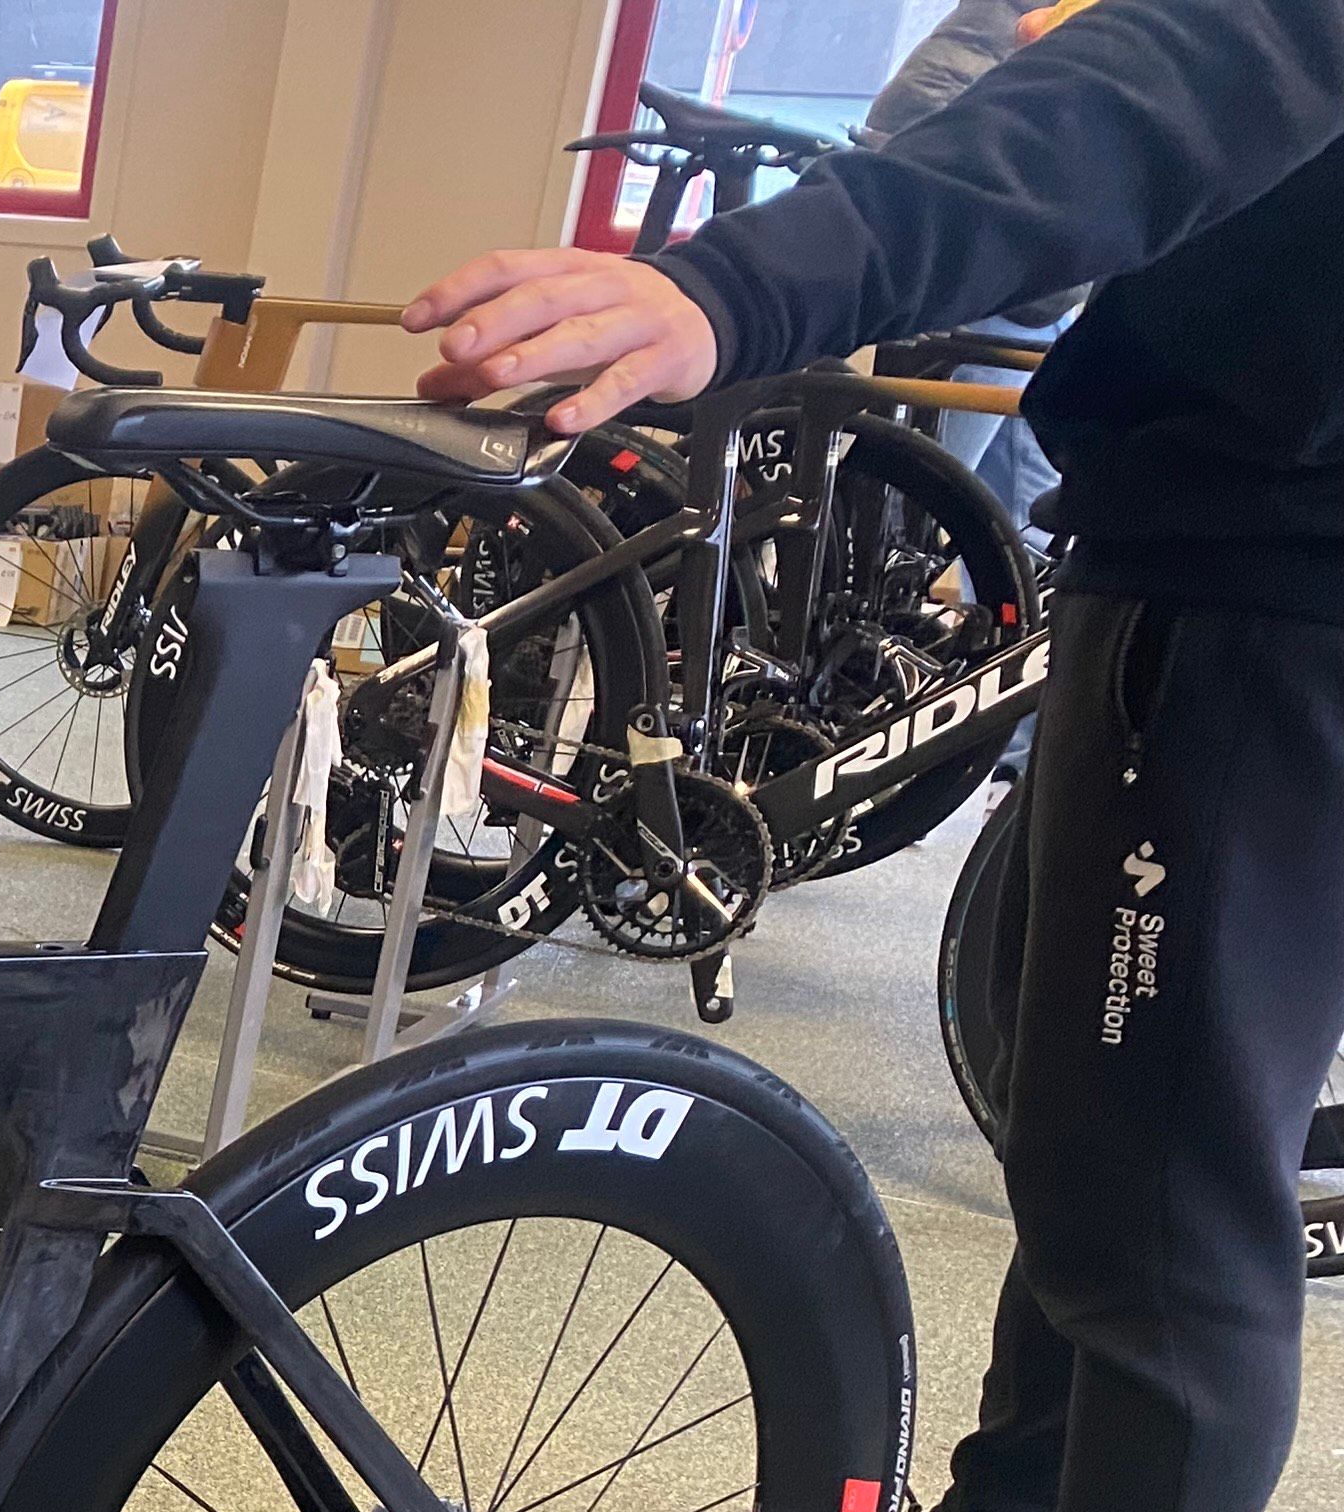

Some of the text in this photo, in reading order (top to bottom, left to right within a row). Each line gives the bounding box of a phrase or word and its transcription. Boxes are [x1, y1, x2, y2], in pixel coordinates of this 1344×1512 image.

[100, 541, 137, 636] RIDLEY
[150, 605, 188, 679] ISS
[814, 640, 1051, 800] RIDLE
[6, 787, 87, 831] SWISS
[497, 872, 551, 930] DT
[1101, 907, 1137, 1044] Protection
[1135, 914, 1165, 998] Sweet
[303, 1081, 695, 1241] SWISS DT
